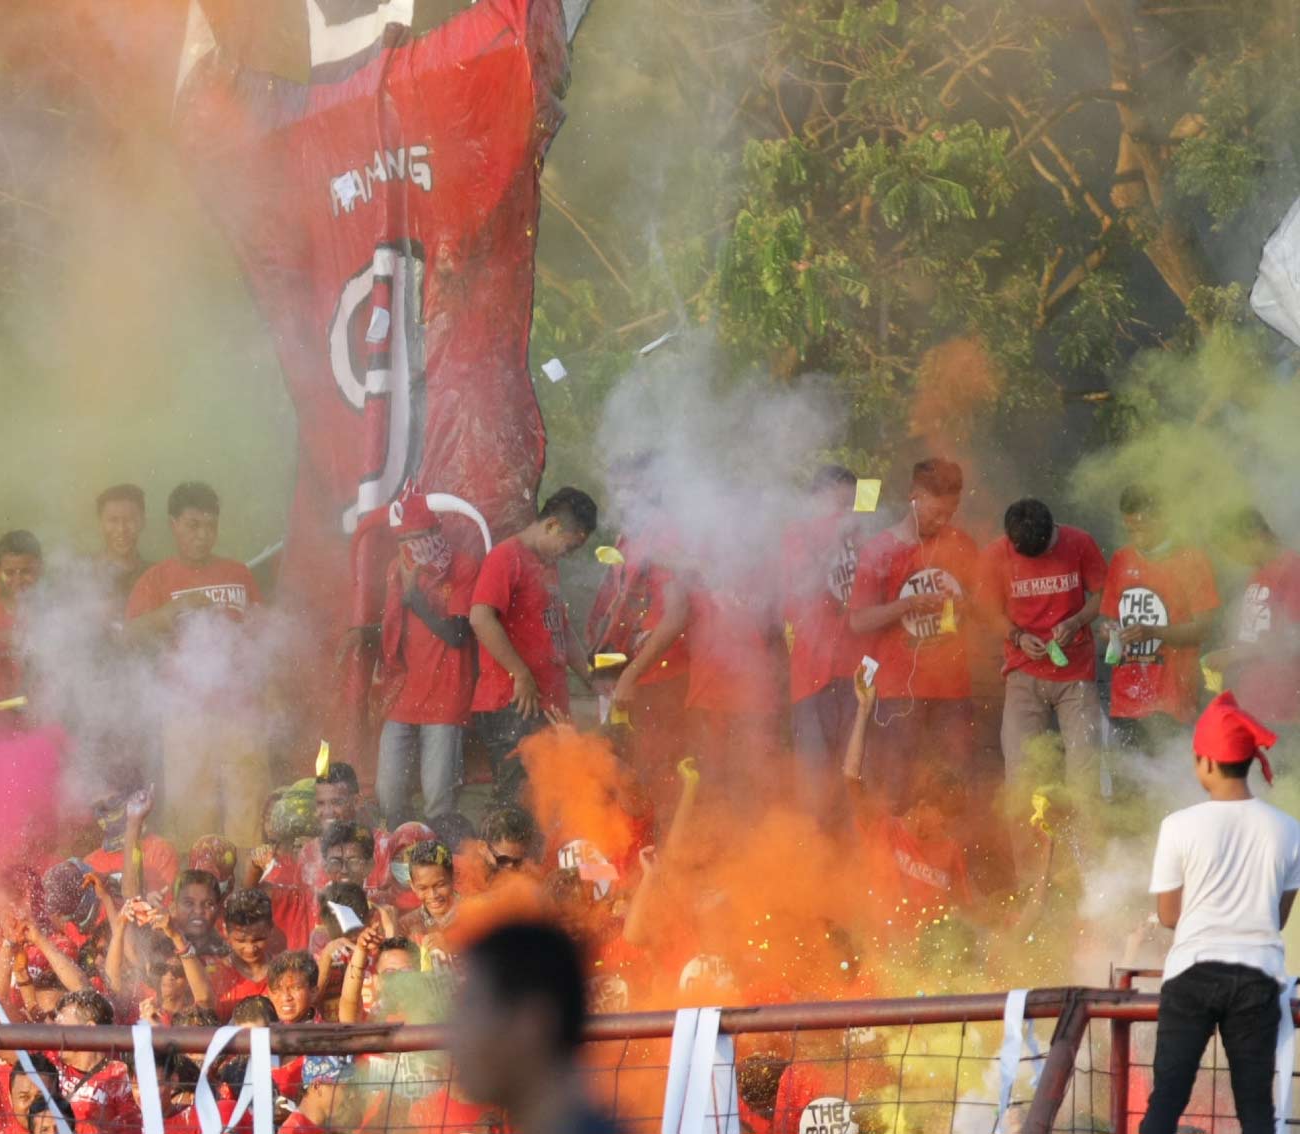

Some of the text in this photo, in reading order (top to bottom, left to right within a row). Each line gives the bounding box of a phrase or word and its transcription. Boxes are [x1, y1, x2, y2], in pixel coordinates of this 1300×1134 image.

[909, 571, 945, 594] THE
[1122, 593, 1155, 614] THE
[807, 1102, 845, 1124] THE
